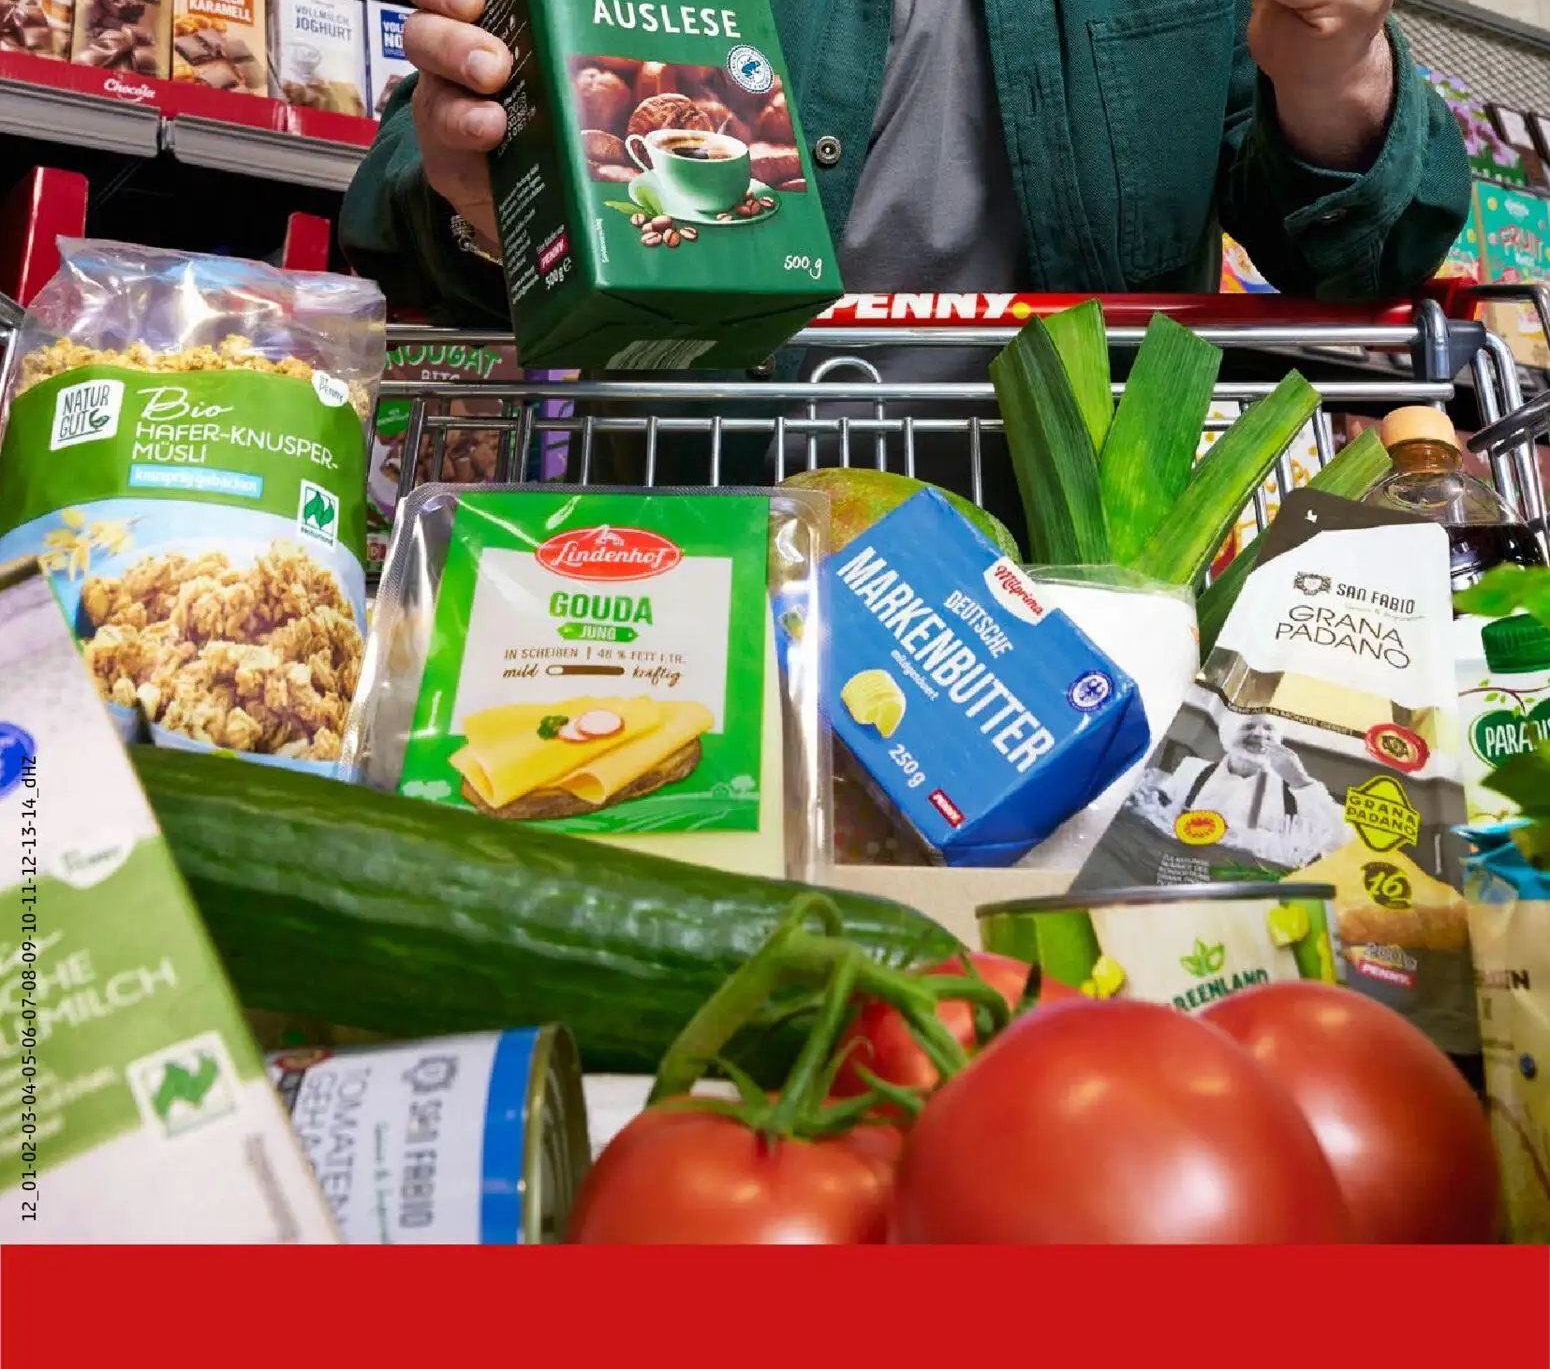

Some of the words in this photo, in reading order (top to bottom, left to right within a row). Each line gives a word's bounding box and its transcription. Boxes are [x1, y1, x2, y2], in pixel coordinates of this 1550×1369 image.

[295, 4, 350, 25] VOLLMILCH
[295, 16, 352, 42] JOGHURT
[383, 20, 405, 33] VOL
[384, 344, 503, 380] NOUGAT
[63, 384, 110, 415] NATUR
[137, 386, 235, 421] Bio
[60, 410, 90, 439] GUT
[131, 440, 206, 464] MÜSLI
[135, 421, 339, 470] HAFER-KNUSPER-
[551, 540, 669, 568] Lindenhof
[994, 565, 1044, 615] Milprima
[1370, 591, 1416, 615] FABIO
[548, 590, 653, 625] GOUDA
[580, 623, 617, 641] JUNG
[943, 589, 1013, 659] DEUTSCHE
[1288, 605, 1404, 650] GRANA
[503, 648, 517, 660] IN
[521, 645, 579, 660] SCHEIBEN
[836, 545, 1056, 774] MARKENBUTTER
[1275, 622, 1411, 670] PADANO
[502, 664, 539, 679] mild
[632, 665, 684, 688] kräftig
[888, 743, 919, 775] 250
[1346, 807, 1416, 836] PADANO
[1349, 795, 1417, 829] GRANA
[1369, 870, 1403, 896] 16
[1168, 967, 1270, 1012] REENLAND
